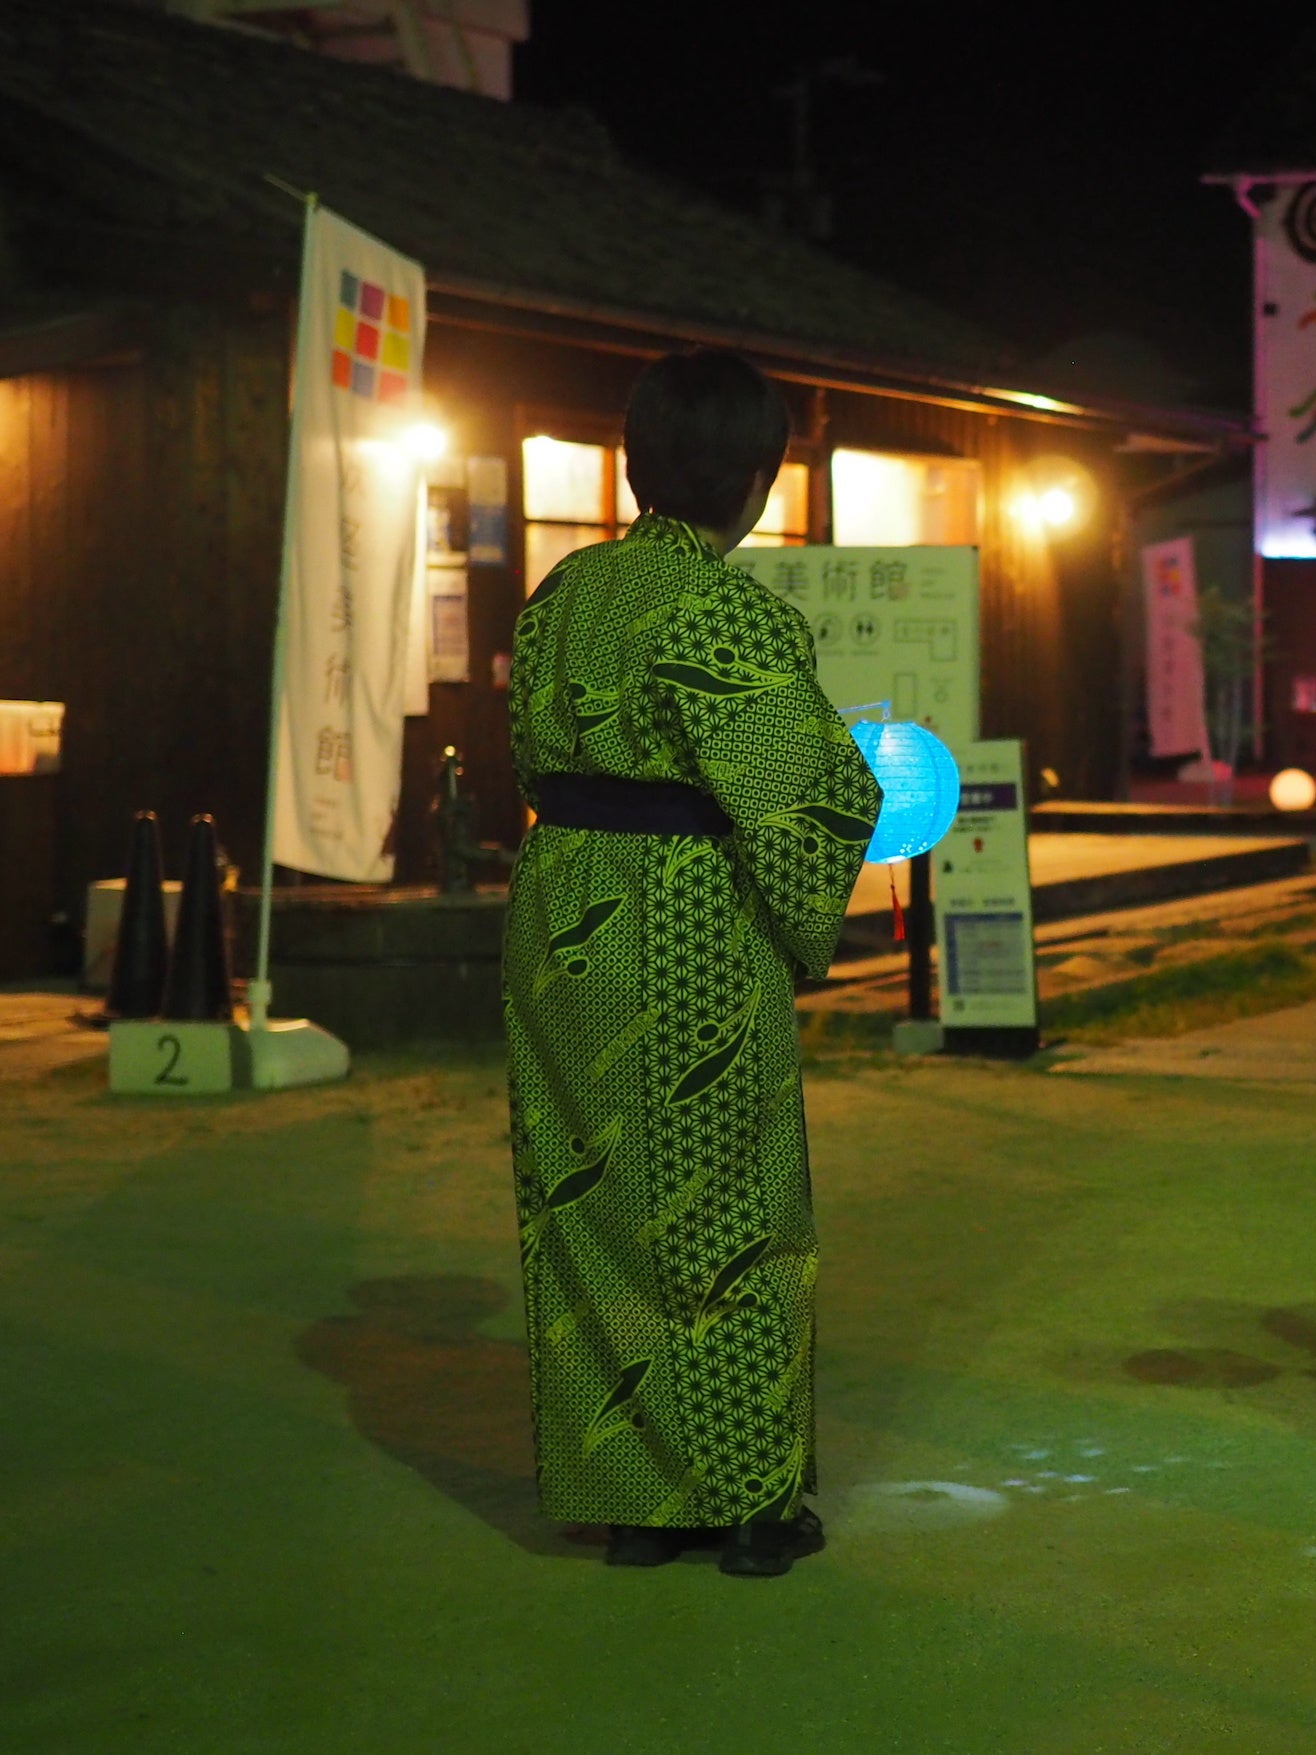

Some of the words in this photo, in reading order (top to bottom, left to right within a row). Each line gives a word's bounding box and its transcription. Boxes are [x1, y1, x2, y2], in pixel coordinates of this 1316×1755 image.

[732, 560, 909, 602] 美術館
[155, 1034, 188, 1085] 2
